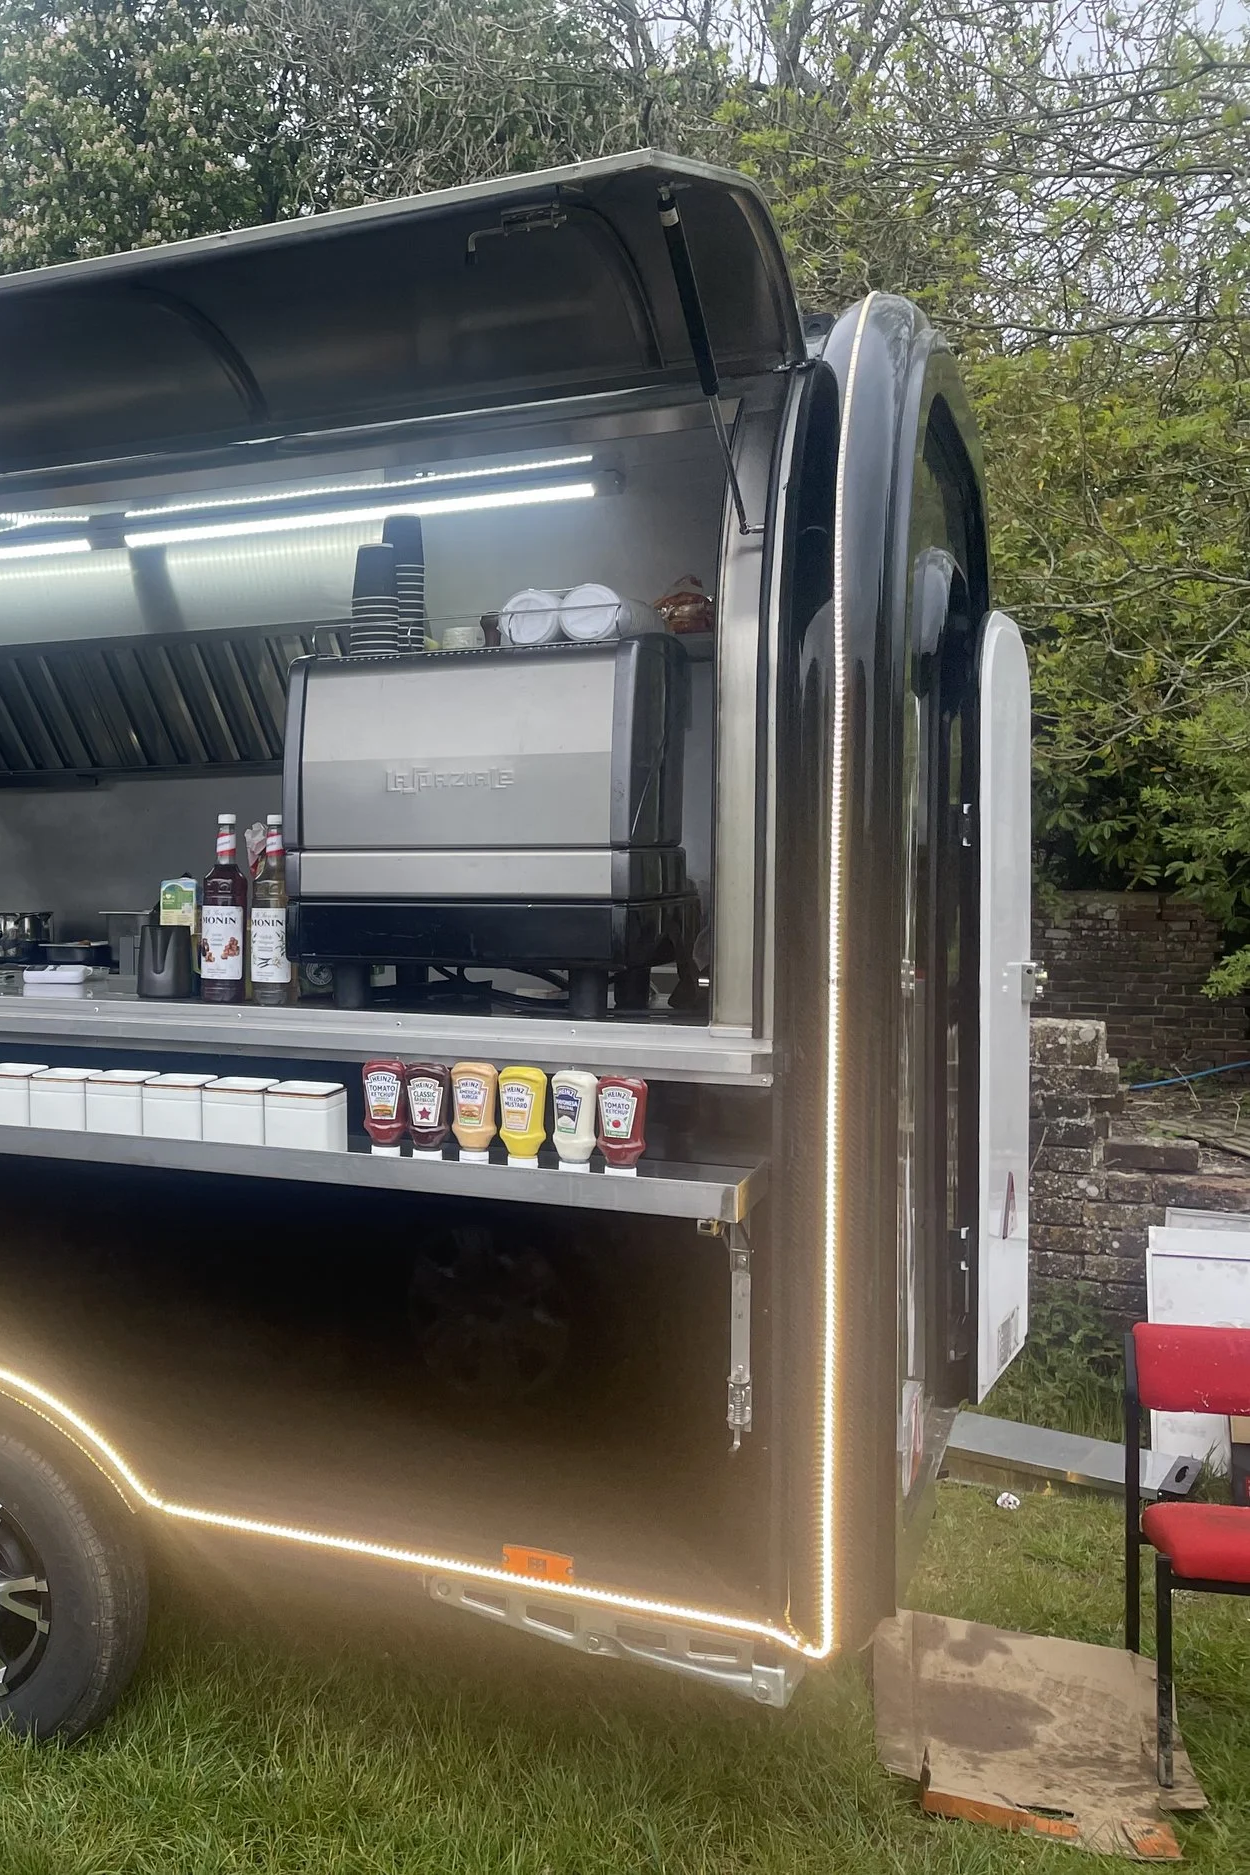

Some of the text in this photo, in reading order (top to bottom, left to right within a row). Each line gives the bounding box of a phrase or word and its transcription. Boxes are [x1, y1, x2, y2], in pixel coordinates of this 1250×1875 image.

[371, 1075, 392, 1083] HEINZ
[369, 1084, 396, 1092] TOMATO
[414, 1082, 434, 1090] HEINZ
[461, 1081, 479, 1089] HEINZ
[413, 1090, 436, 1098] CLASSIC
[506, 1086, 525, 1095] HEINZ
[607, 1091, 627, 1099] HEINZ
[504, 1101, 528, 1109] MUSTARD
[604, 1101, 630, 1110] TOMATO
[606, 1108, 629, 1116] KETCHUP
